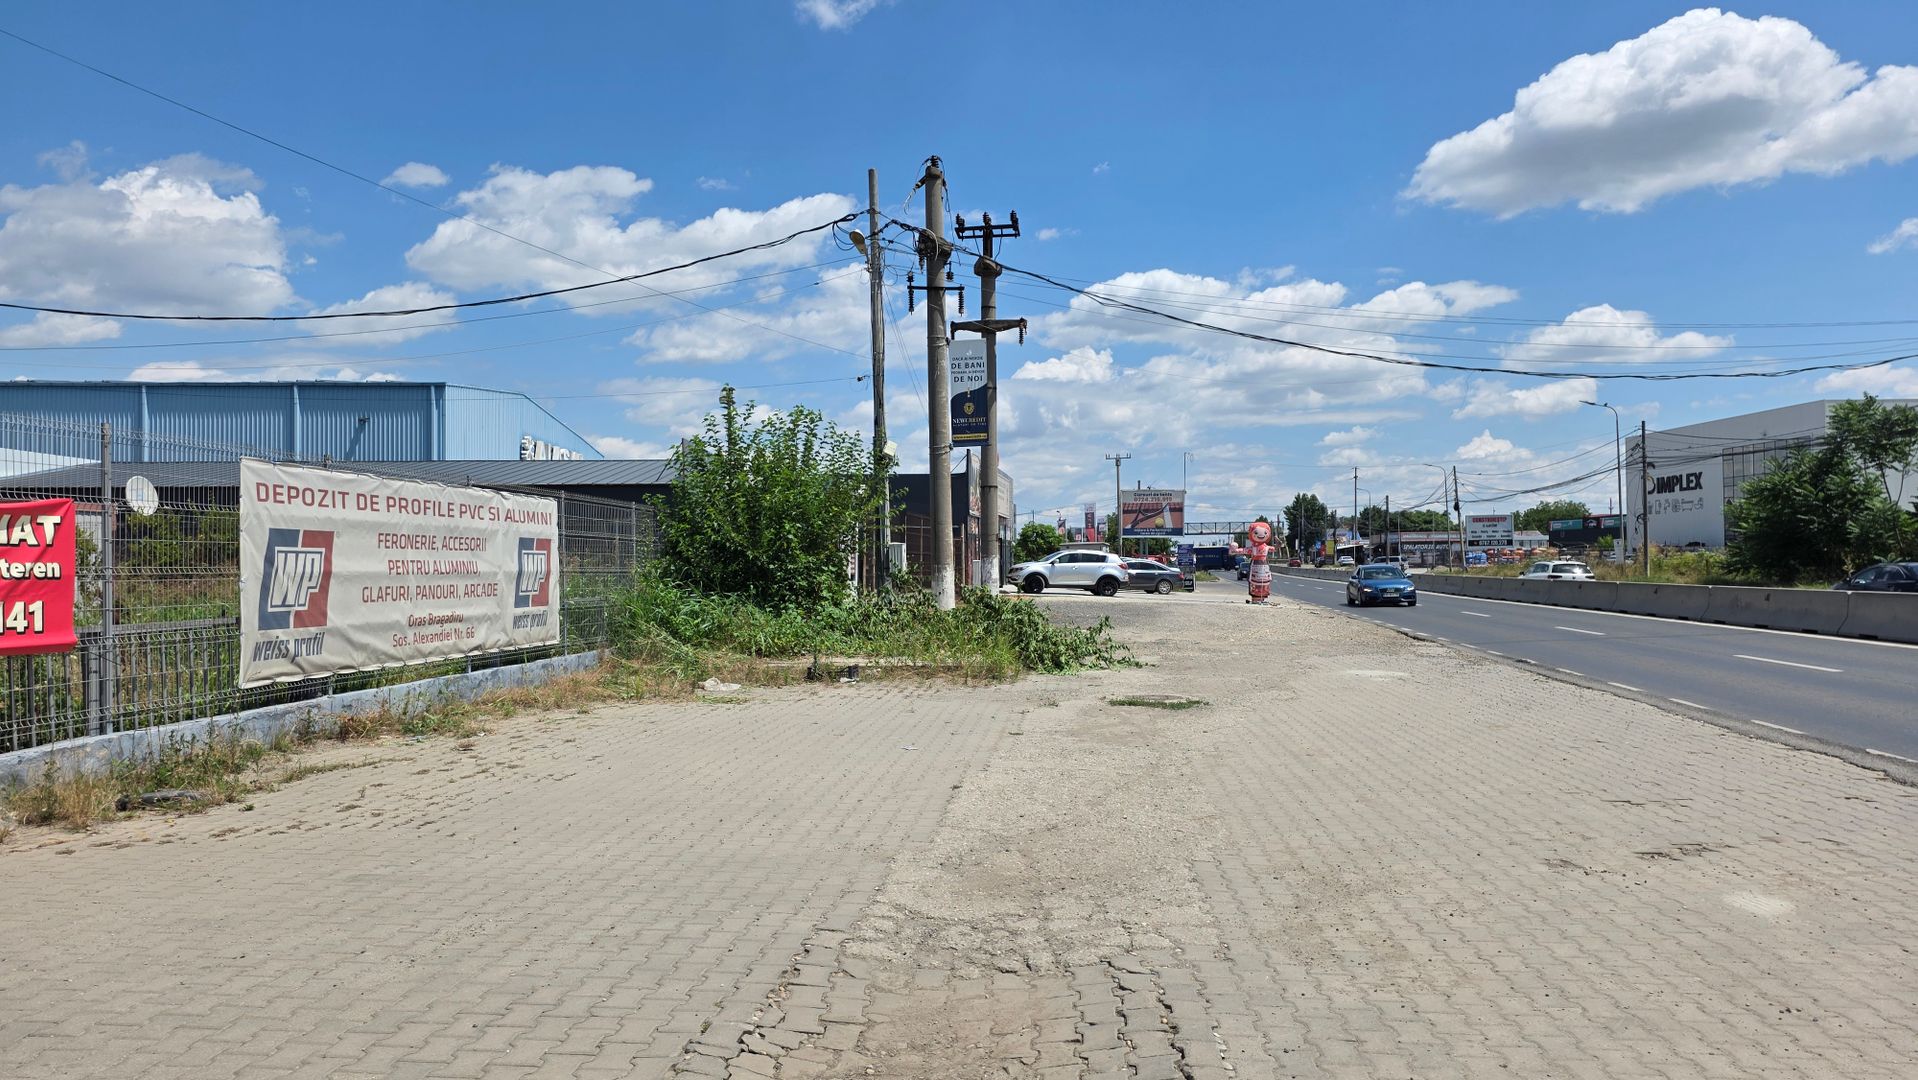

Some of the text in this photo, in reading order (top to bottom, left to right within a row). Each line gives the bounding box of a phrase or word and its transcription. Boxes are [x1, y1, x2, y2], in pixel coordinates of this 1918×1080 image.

[964, 361, 985, 369] BANI
[256, 482, 350, 510] DEPOZIT
[356, 493, 380, 512] DE
[386, 496, 455, 518] PROFILE
[459, 503, 485, 521] PVC
[488, 506, 501, 521] SI
[378, 533, 487, 552] FERONERIE, ACCESORII
[388, 560, 481, 577] PENTRU ALUMINIU,
[362, 583, 498, 604] GLAFURI, PANOURI, ARCADE
[408, 611, 464, 628] Oras Bragadiru
[392, 633, 411, 648] Sos.
[465, 626, 475, 639] 66
[252, 631, 326, 664] weiss profil
